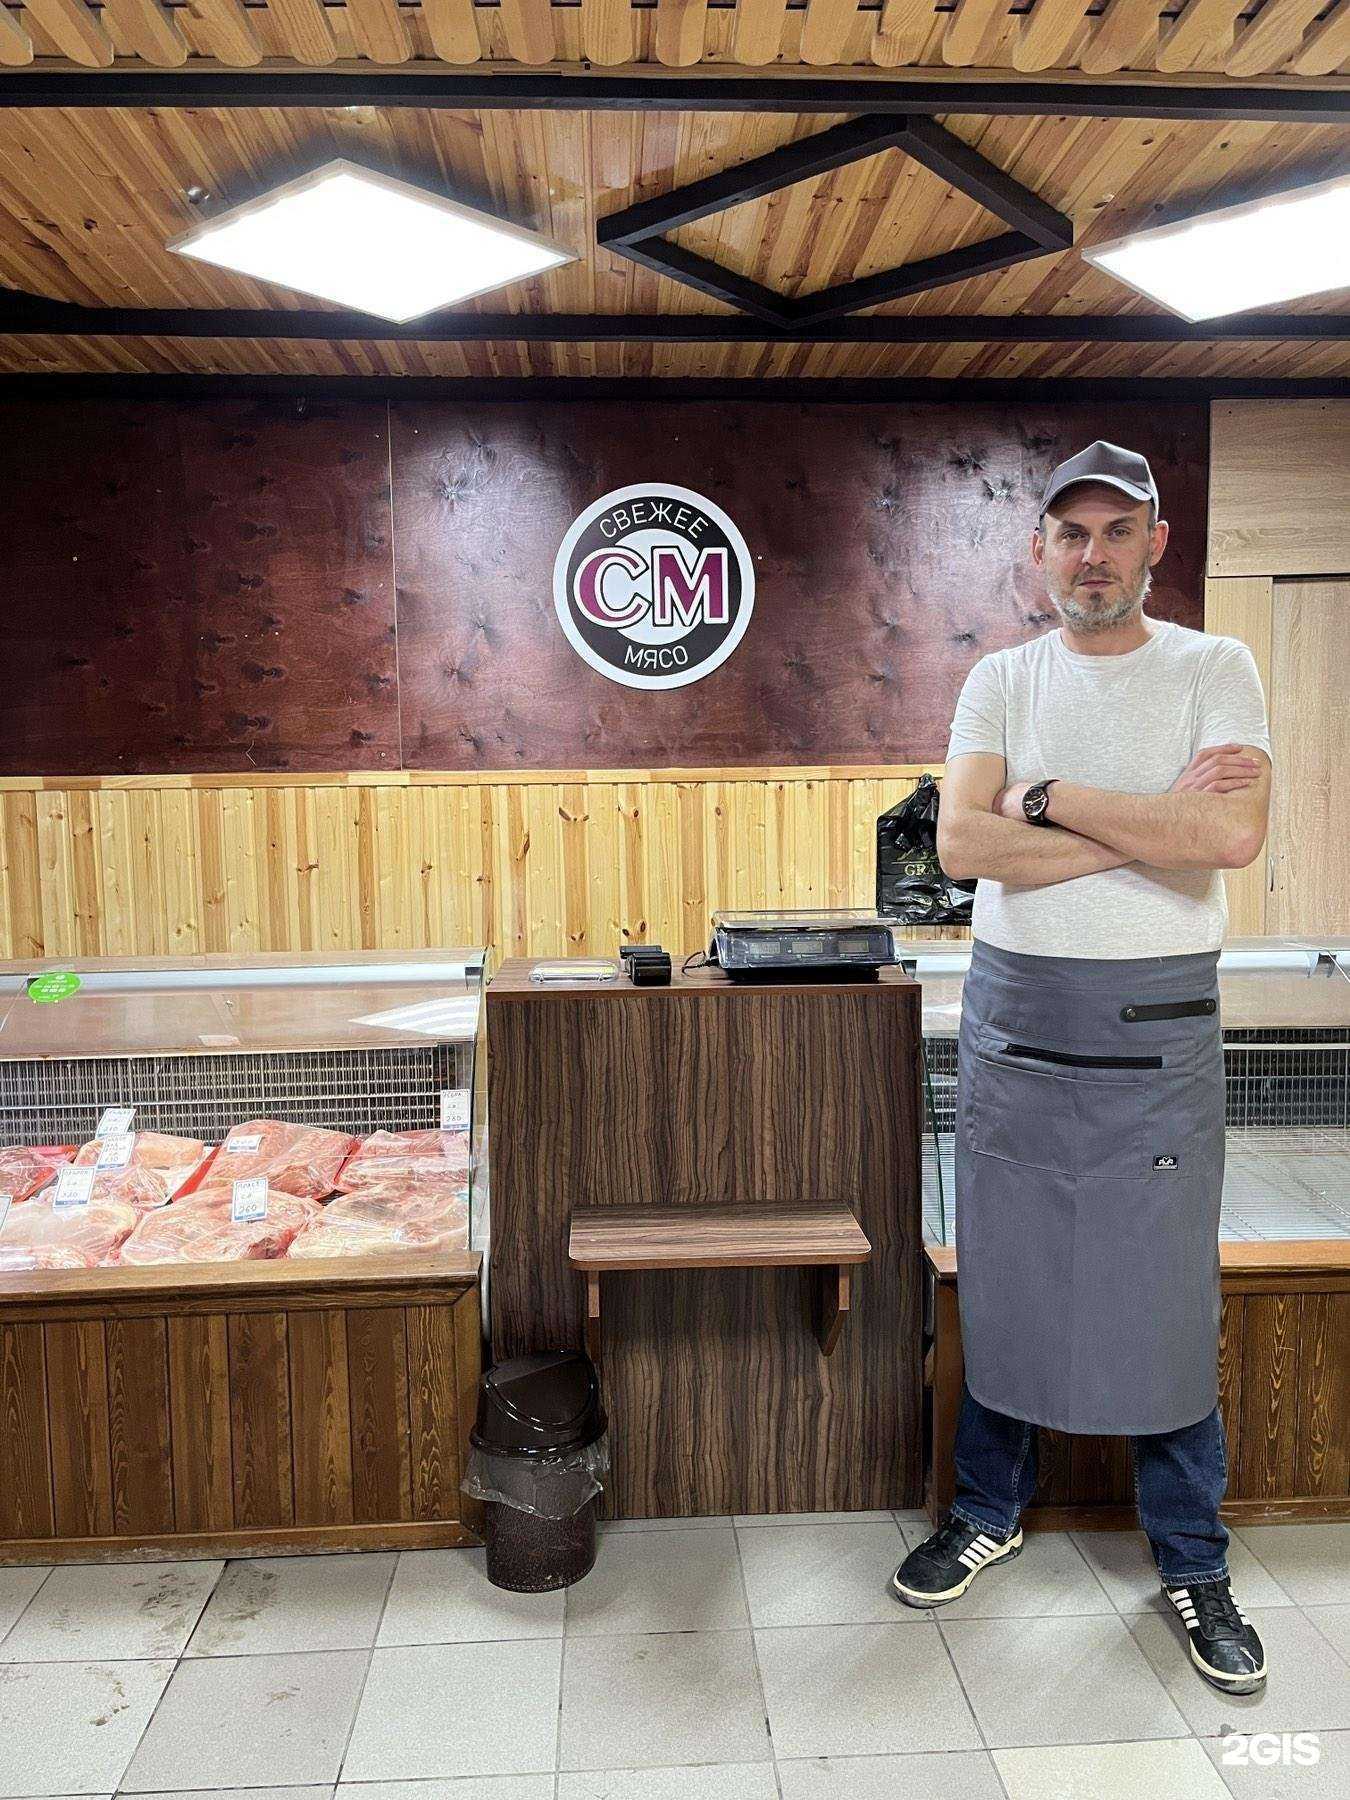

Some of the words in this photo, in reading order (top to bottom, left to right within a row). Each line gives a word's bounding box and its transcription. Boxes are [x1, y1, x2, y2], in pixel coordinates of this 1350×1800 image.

[599, 501, 709, 539] СВЕЖЕЕ
[573, 546, 729, 627] СМ
[624, 645, 689, 669] МЯСО
